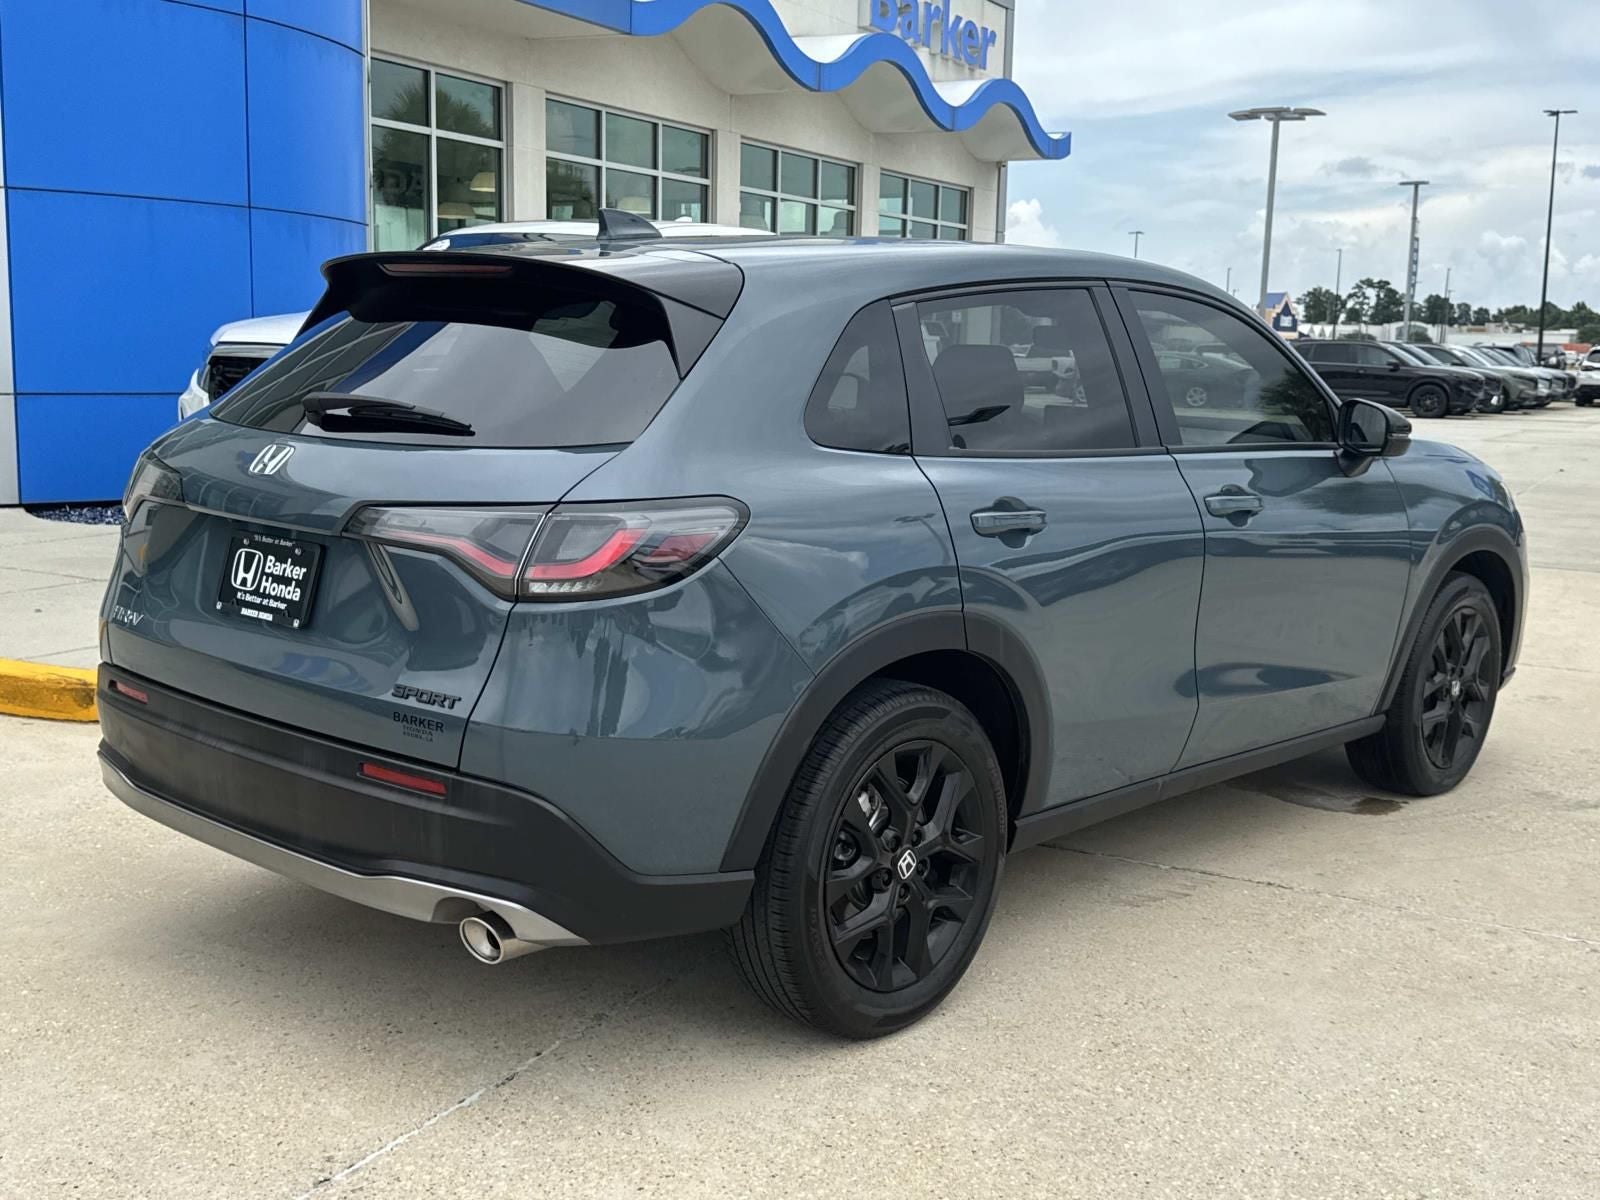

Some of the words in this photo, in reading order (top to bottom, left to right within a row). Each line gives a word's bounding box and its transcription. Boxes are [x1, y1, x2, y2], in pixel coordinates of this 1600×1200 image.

[264, 555, 307, 580] Barker
[260, 575, 301, 601] Honda
[245, 593, 262, 604] Better
[269, 598, 287, 610] Barker
[391, 684, 462, 710] SPORT
[393, 712, 444, 733] BARKER
